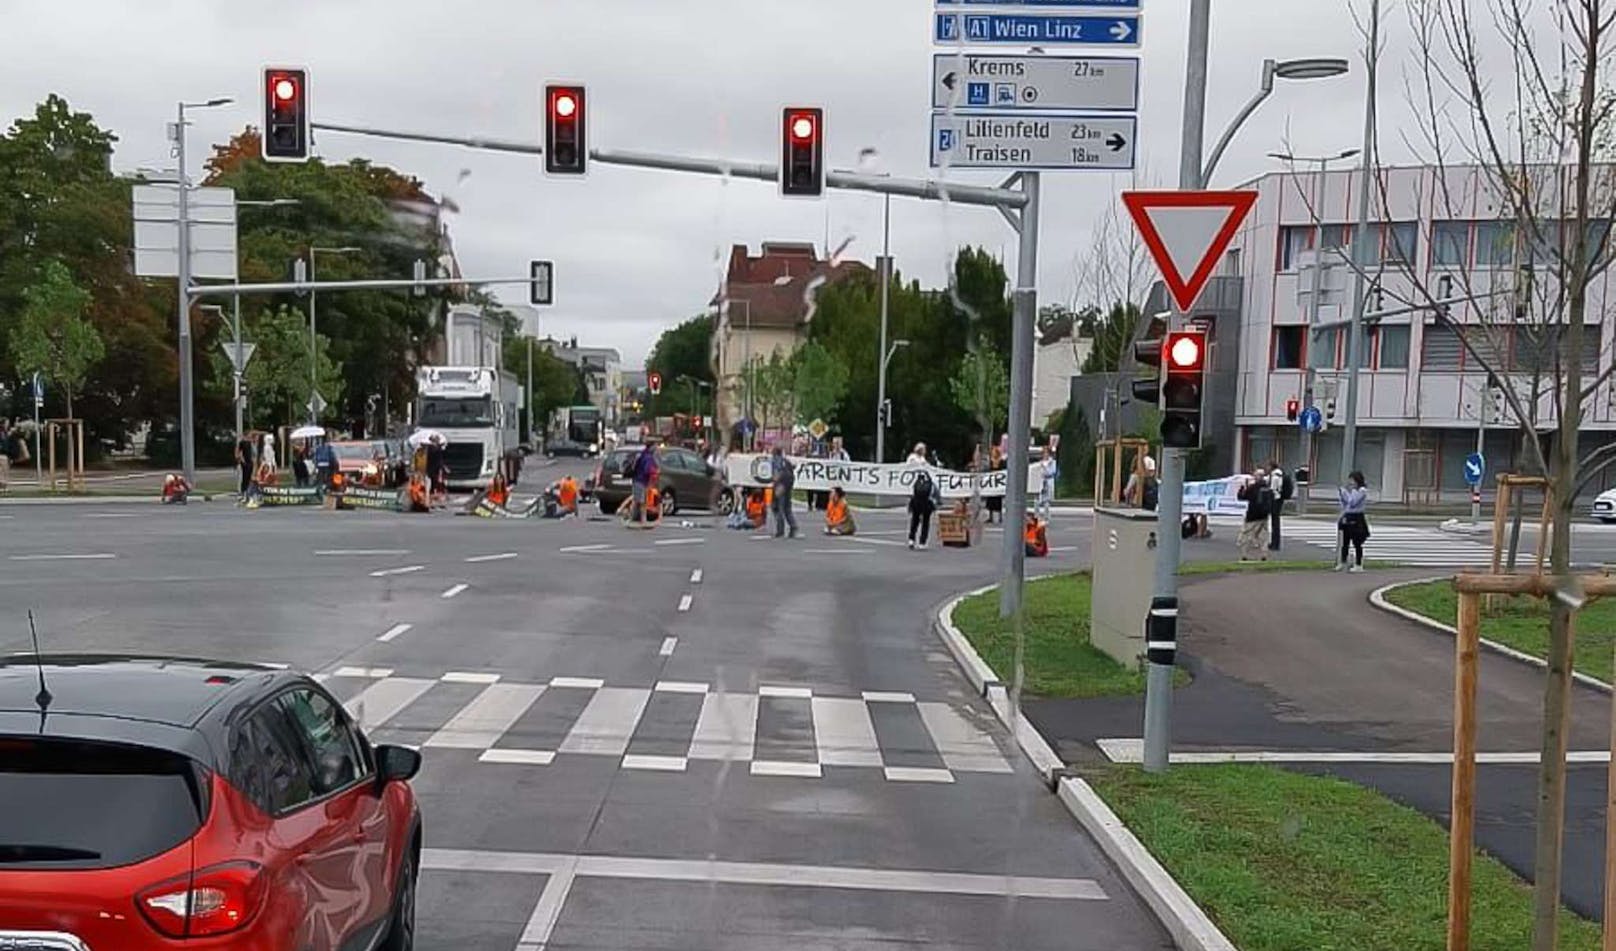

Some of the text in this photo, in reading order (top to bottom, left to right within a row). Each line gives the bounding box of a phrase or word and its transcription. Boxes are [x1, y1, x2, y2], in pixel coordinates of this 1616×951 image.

[971, 19, 988, 37] A1
[995, 19, 1038, 37] Wien
[1045, 20, 1082, 39] Linz
[968, 58, 1025, 76] Krems
[1074, 62, 1089, 76] 27
[966, 120, 1050, 140] Lilienfeld
[1071, 124, 1086, 140] 23
[966, 144, 1031, 162] Traisen
[1072, 148, 1086, 163] 18
[794, 462, 880, 485] ARENTS
[935, 472, 1008, 490] FUTUR
